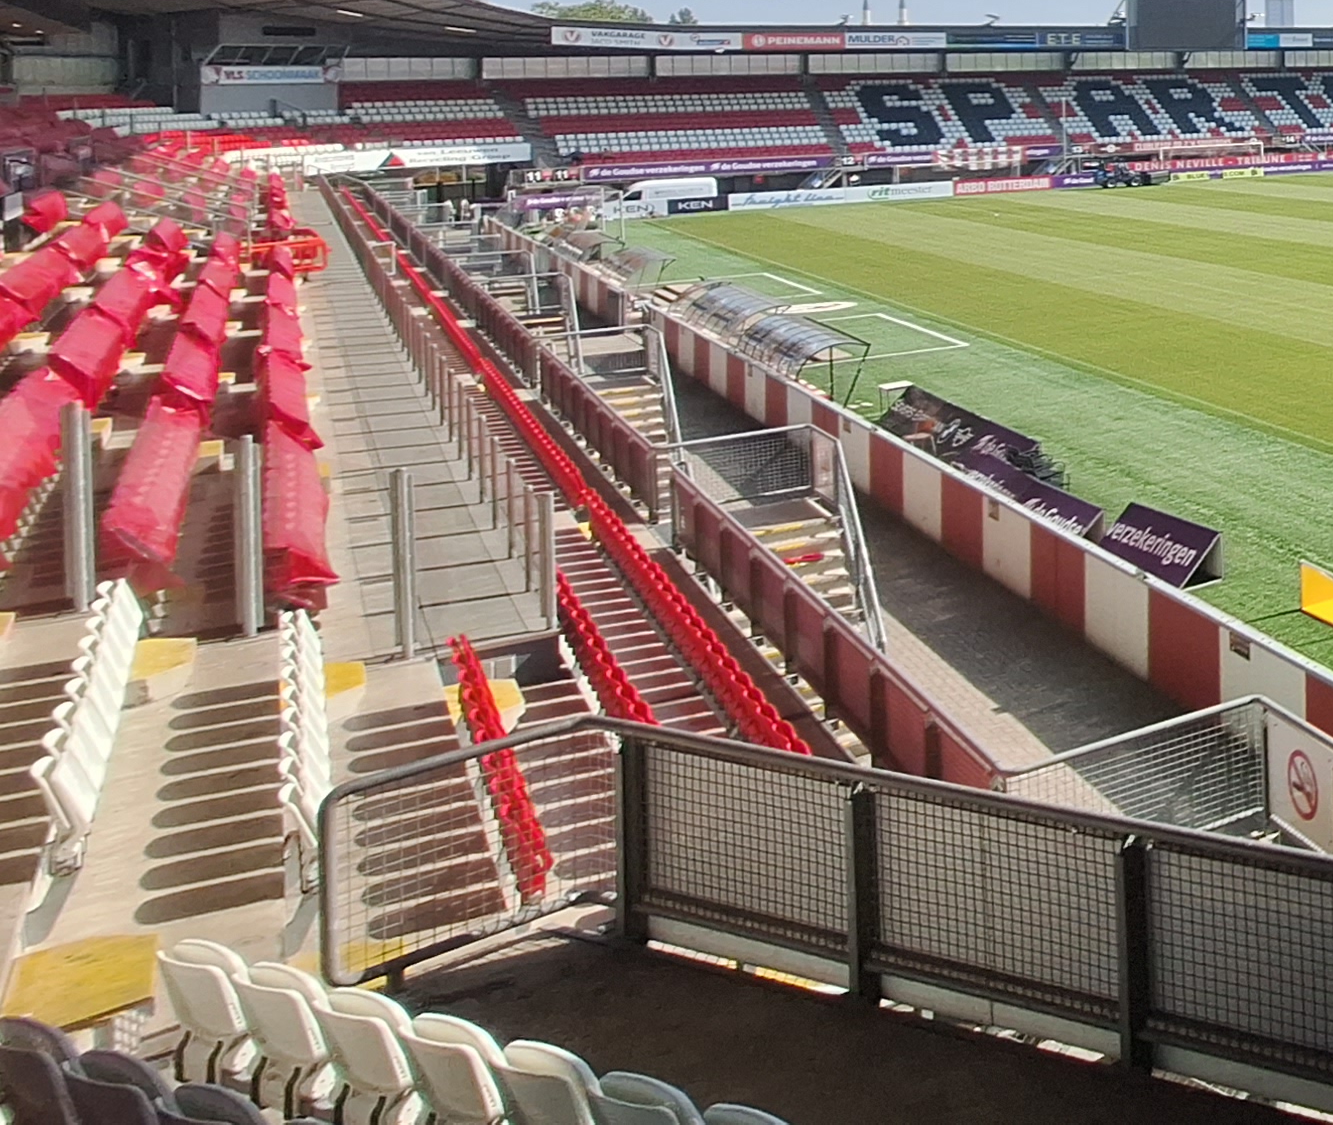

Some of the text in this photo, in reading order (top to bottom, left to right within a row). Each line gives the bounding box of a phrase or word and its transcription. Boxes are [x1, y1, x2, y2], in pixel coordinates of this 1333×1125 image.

[591, 31, 646, 39] VAKGARAGE
[848, 35, 895, 44] MULDER
[767, 36, 841, 45] PEINEMANN
[841, 156, 854, 165] 12
[1135, 161, 1171, 171] DENIS
[1176, 157, 1224, 169] NEVILLE
[1237, 154, 1285, 165] TRIBUNE
[721, 163, 731, 171] de
[526, 171, 542, 181] 11
[555, 170, 568, 180] 11
[986, 177, 1050, 192] ROTTERDAM
[613, 204, 649, 214] KEN
[677, 200, 713, 210] KEN
[1106, 521, 1197, 567] verzekeringen
